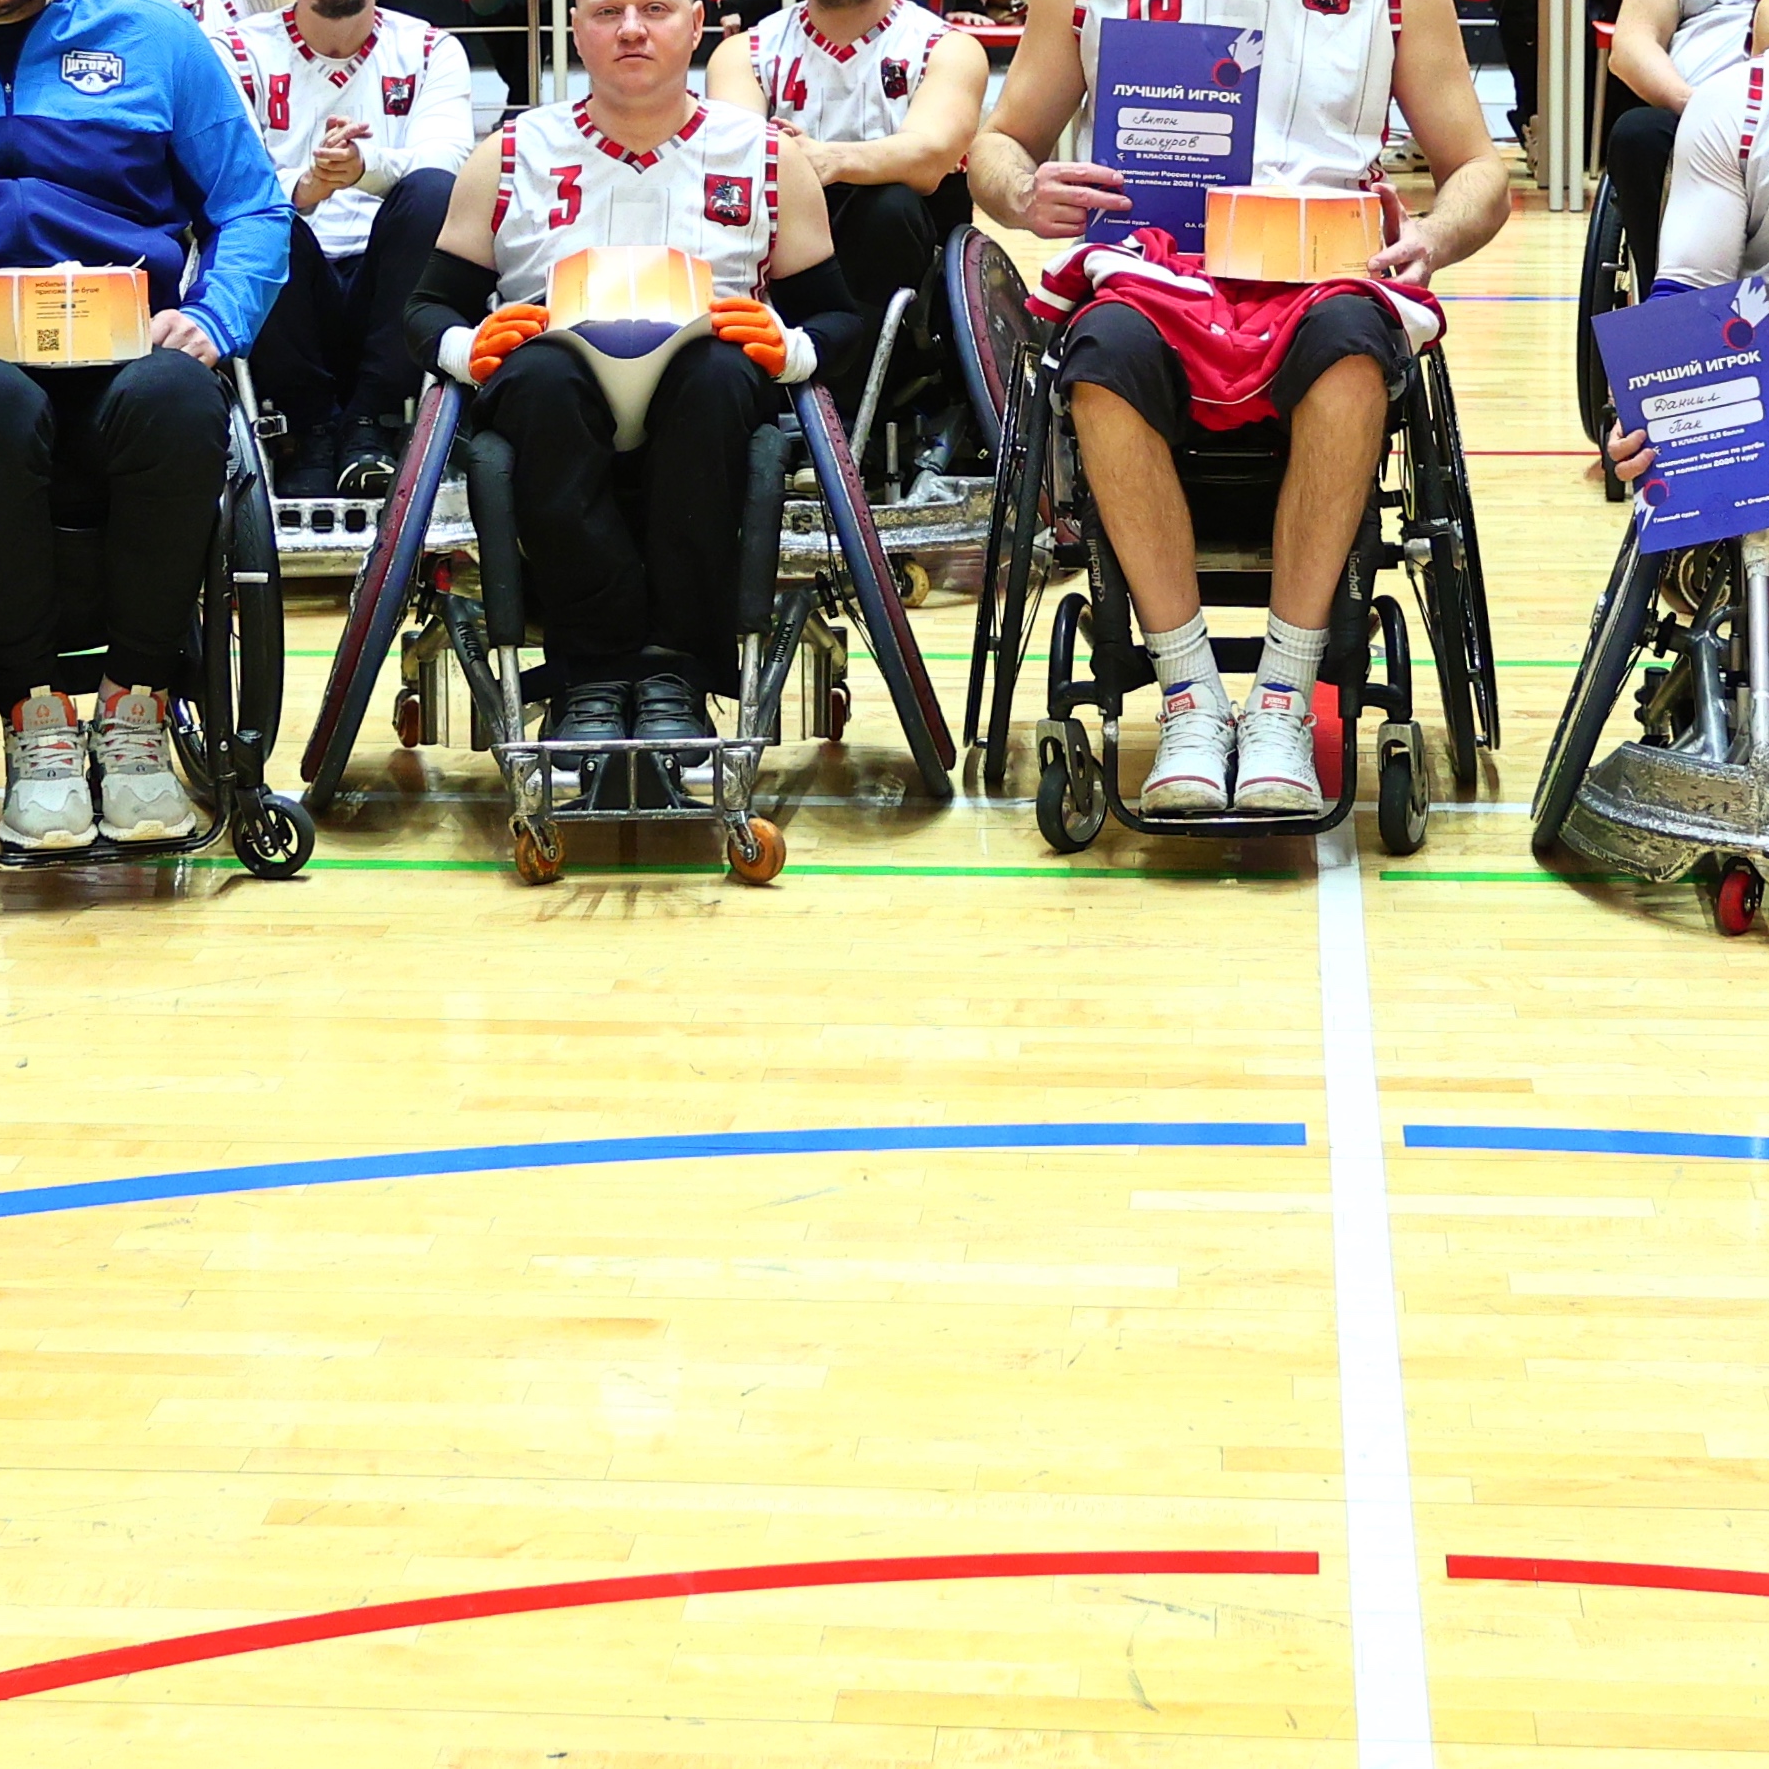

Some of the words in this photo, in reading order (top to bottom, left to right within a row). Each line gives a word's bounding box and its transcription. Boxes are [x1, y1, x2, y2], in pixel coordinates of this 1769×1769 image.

[65, 58, 119, 77] ШТОРМ
[769, 54, 808, 112] 14
[268, 73, 291, 131] 8
[1113, 84, 1184, 100] ЛУЧШИЙ
[1188, 88, 1242, 104] ИГРОК
[1133, 111, 1179, 126] Антон
[1143, 153, 1173, 161] КЛАССЕ
[549, 165, 583, 230] 3
[1628, 359, 1703, 390] ЛУЧШИЙ
[1706, 350, 1762, 372] ИГРОК
[1654, 393, 1721, 412] Даниил
[1668, 419, 1703, 434] Пак
[1678, 434, 1708, 446] КЛАССЕ
